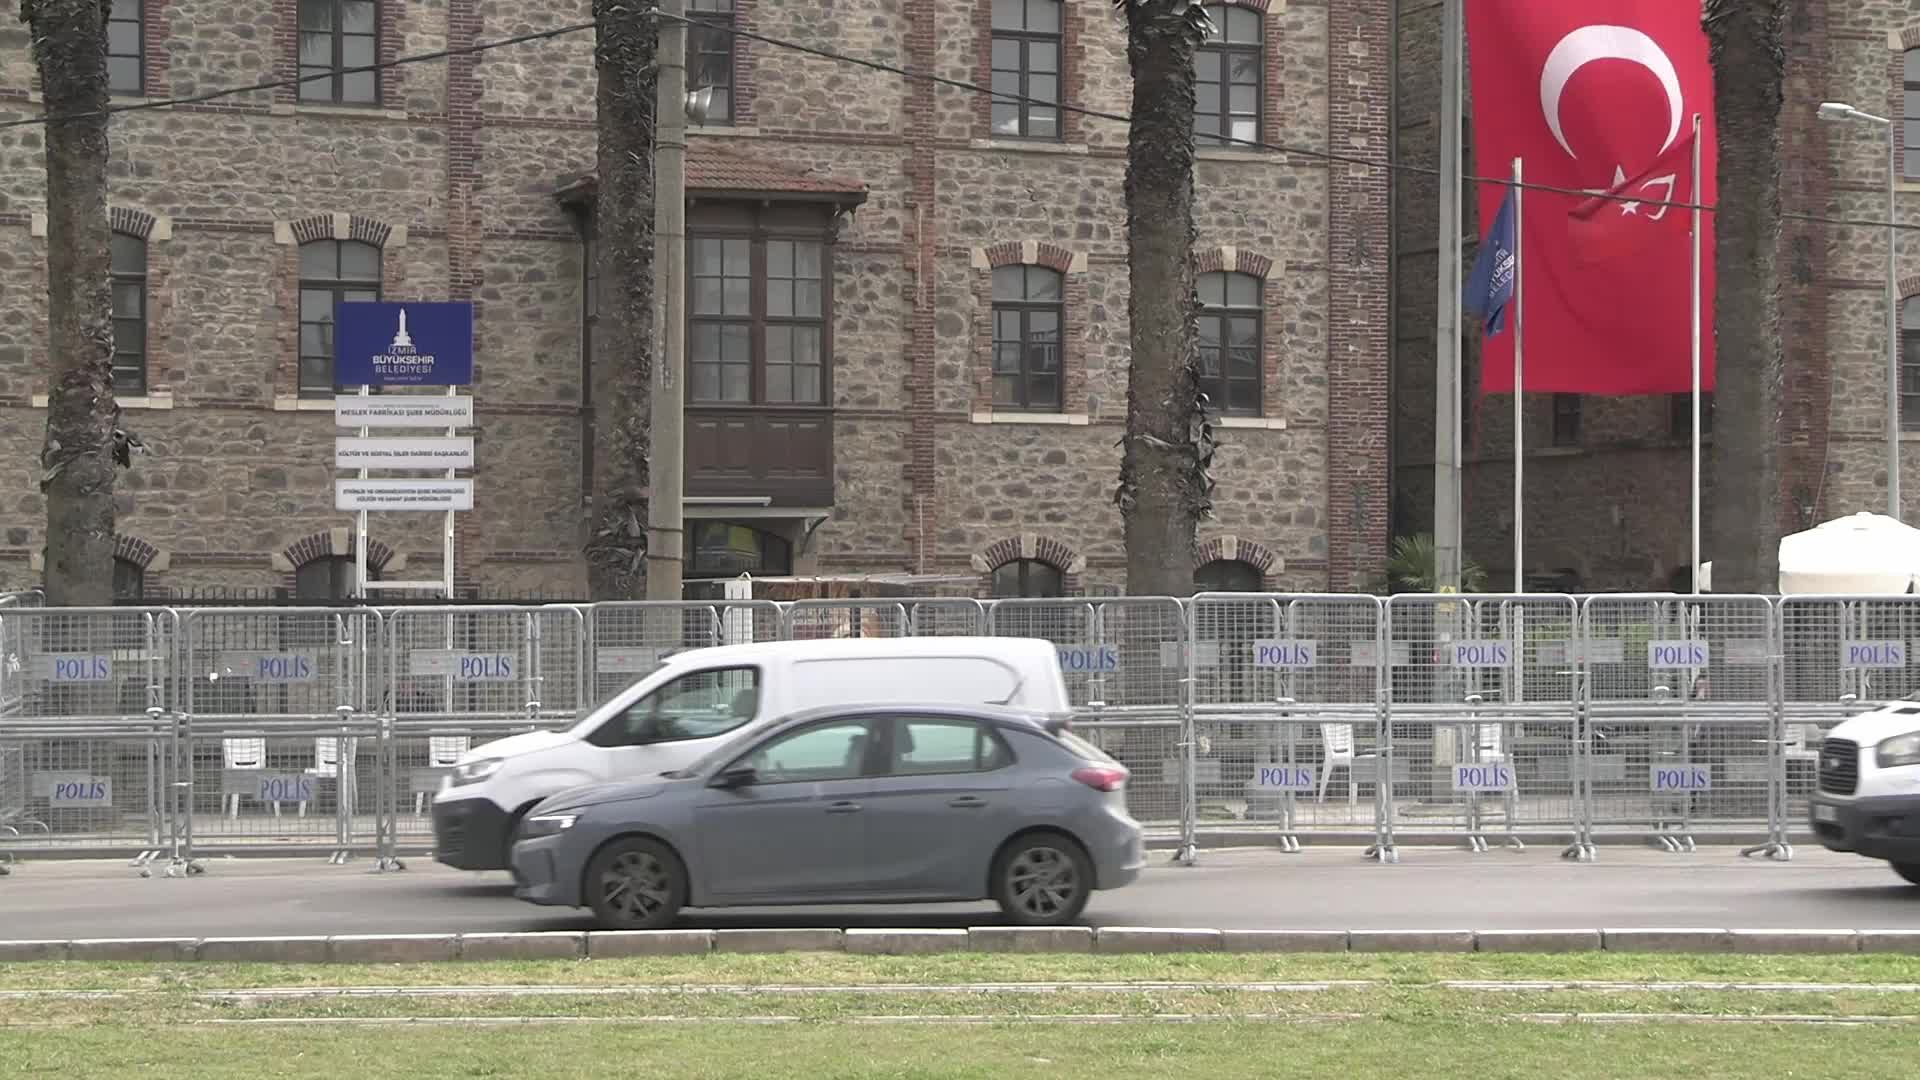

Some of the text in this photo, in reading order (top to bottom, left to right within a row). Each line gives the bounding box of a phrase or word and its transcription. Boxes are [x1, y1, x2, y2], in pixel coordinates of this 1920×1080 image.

[1259, 644, 1310, 665] POLİS
[1457, 644, 1507, 665] POLİS
[1655, 644, 1703, 665] POLİS
[1849, 644, 1899, 665] POLİS
[55, 654, 109, 680] POLİS
[258, 655, 310, 679] POLİS
[460, 654, 510, 678] POLİS
[1260, 765, 1311, 787] POLİS
[1459, 764, 1509, 787] POLİS
[1657, 766, 1706, 788] POLİS
[55, 782, 106, 801] POLİS
[260, 775, 311, 801] POLİS
